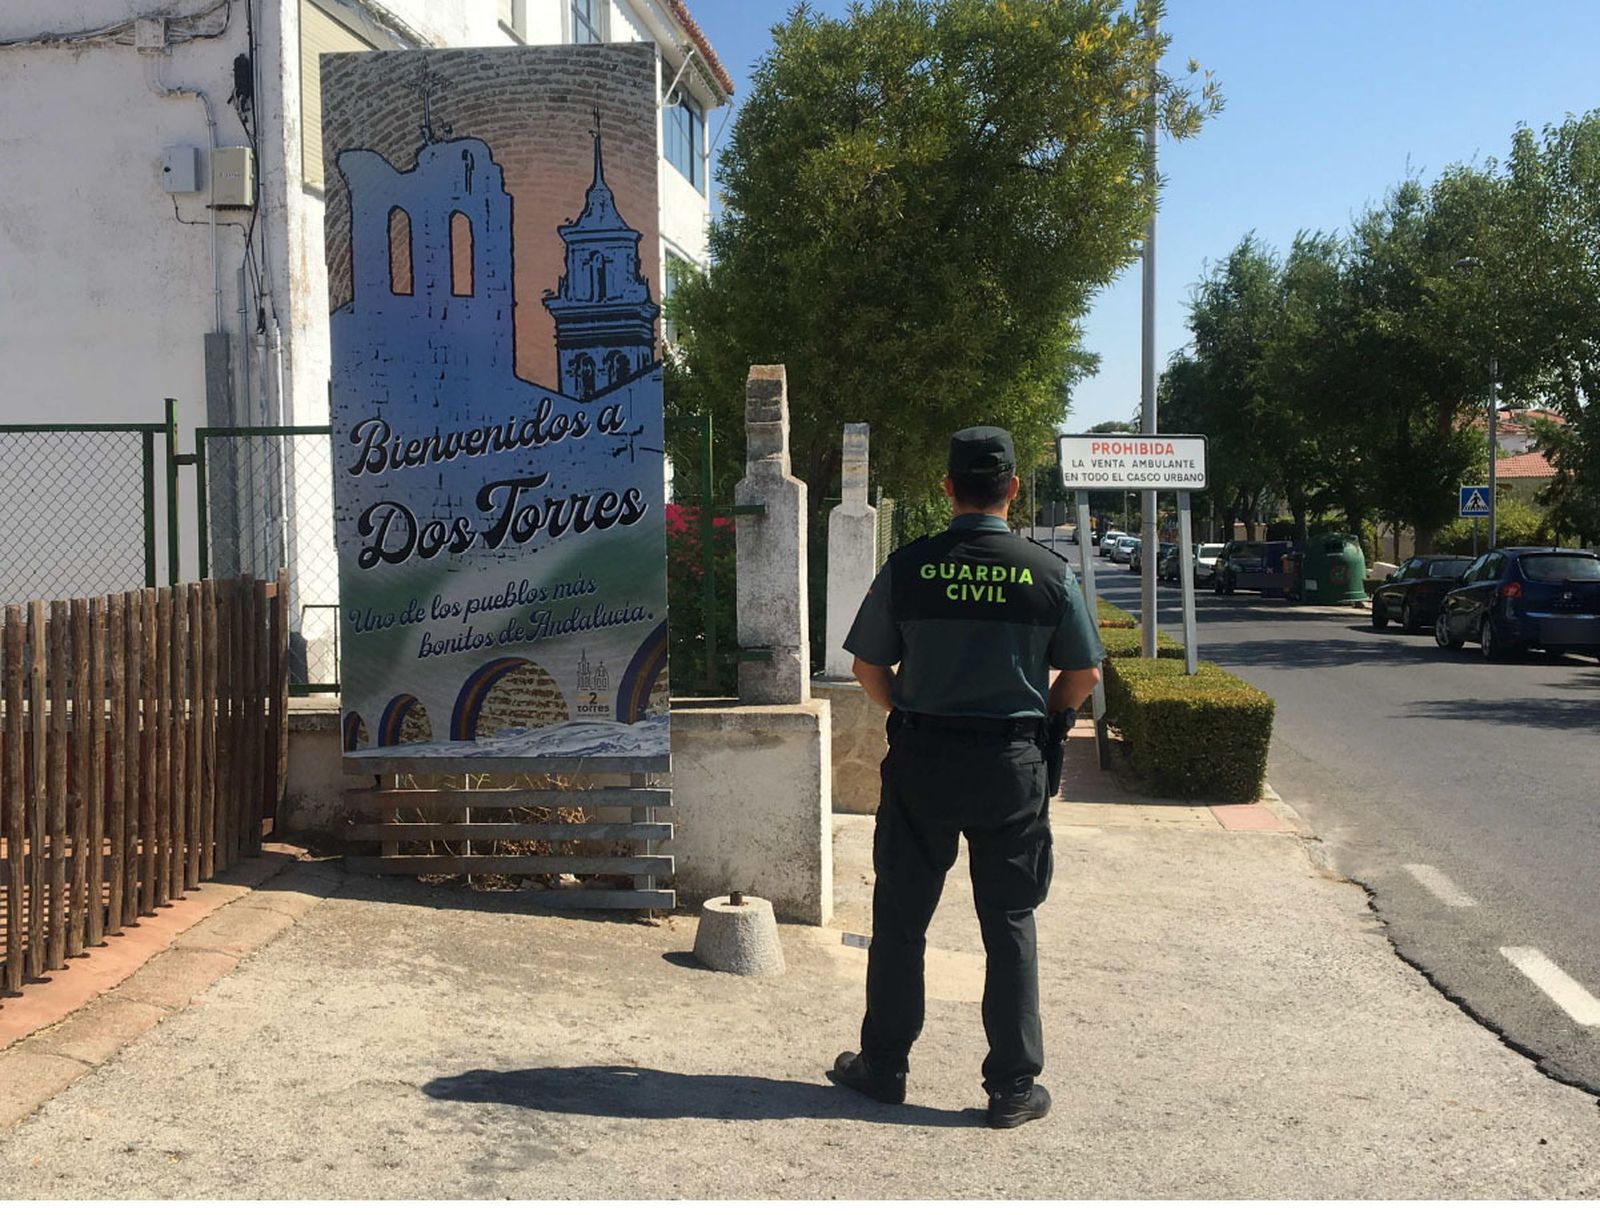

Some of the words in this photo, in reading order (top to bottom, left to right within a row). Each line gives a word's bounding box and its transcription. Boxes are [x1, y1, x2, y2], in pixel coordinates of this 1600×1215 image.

[349, 397, 592, 477] Bienvenidos
[596, 403, 627, 434] a
[1091, 442, 1174, 455] PROHIBIDA
[1072, 459, 1085, 468] LA
[1091, 459, 1125, 468] VENTA
[1132, 459, 1195, 469] AMBULANTE
[1065, 472, 1078, 482] EN
[1082, 472, 1109, 482] TODO
[1112, 472, 1124, 482] EL
[1127, 472, 1161, 482] CASCO
[1164, 472, 1204, 482] URBANO
[357, 501, 479, 570] Dos
[475, 472, 649, 550] Torres
[920, 563, 1033, 585] GUARDIA
[946, 584, 1006, 602] CIVIL
[349, 607, 396, 635] Uno
[400, 598, 427, 626] de
[431, 594, 462, 621] los
[462, 578, 550, 624] pueblos
[552, 571, 598, 601] más
[417, 626, 497, 659] bonitos
[499, 617, 527, 645] de
[523, 601, 656, 642] Andalucía.
[589, 691, 598, 704] 2
[577, 704, 610, 713] torres
